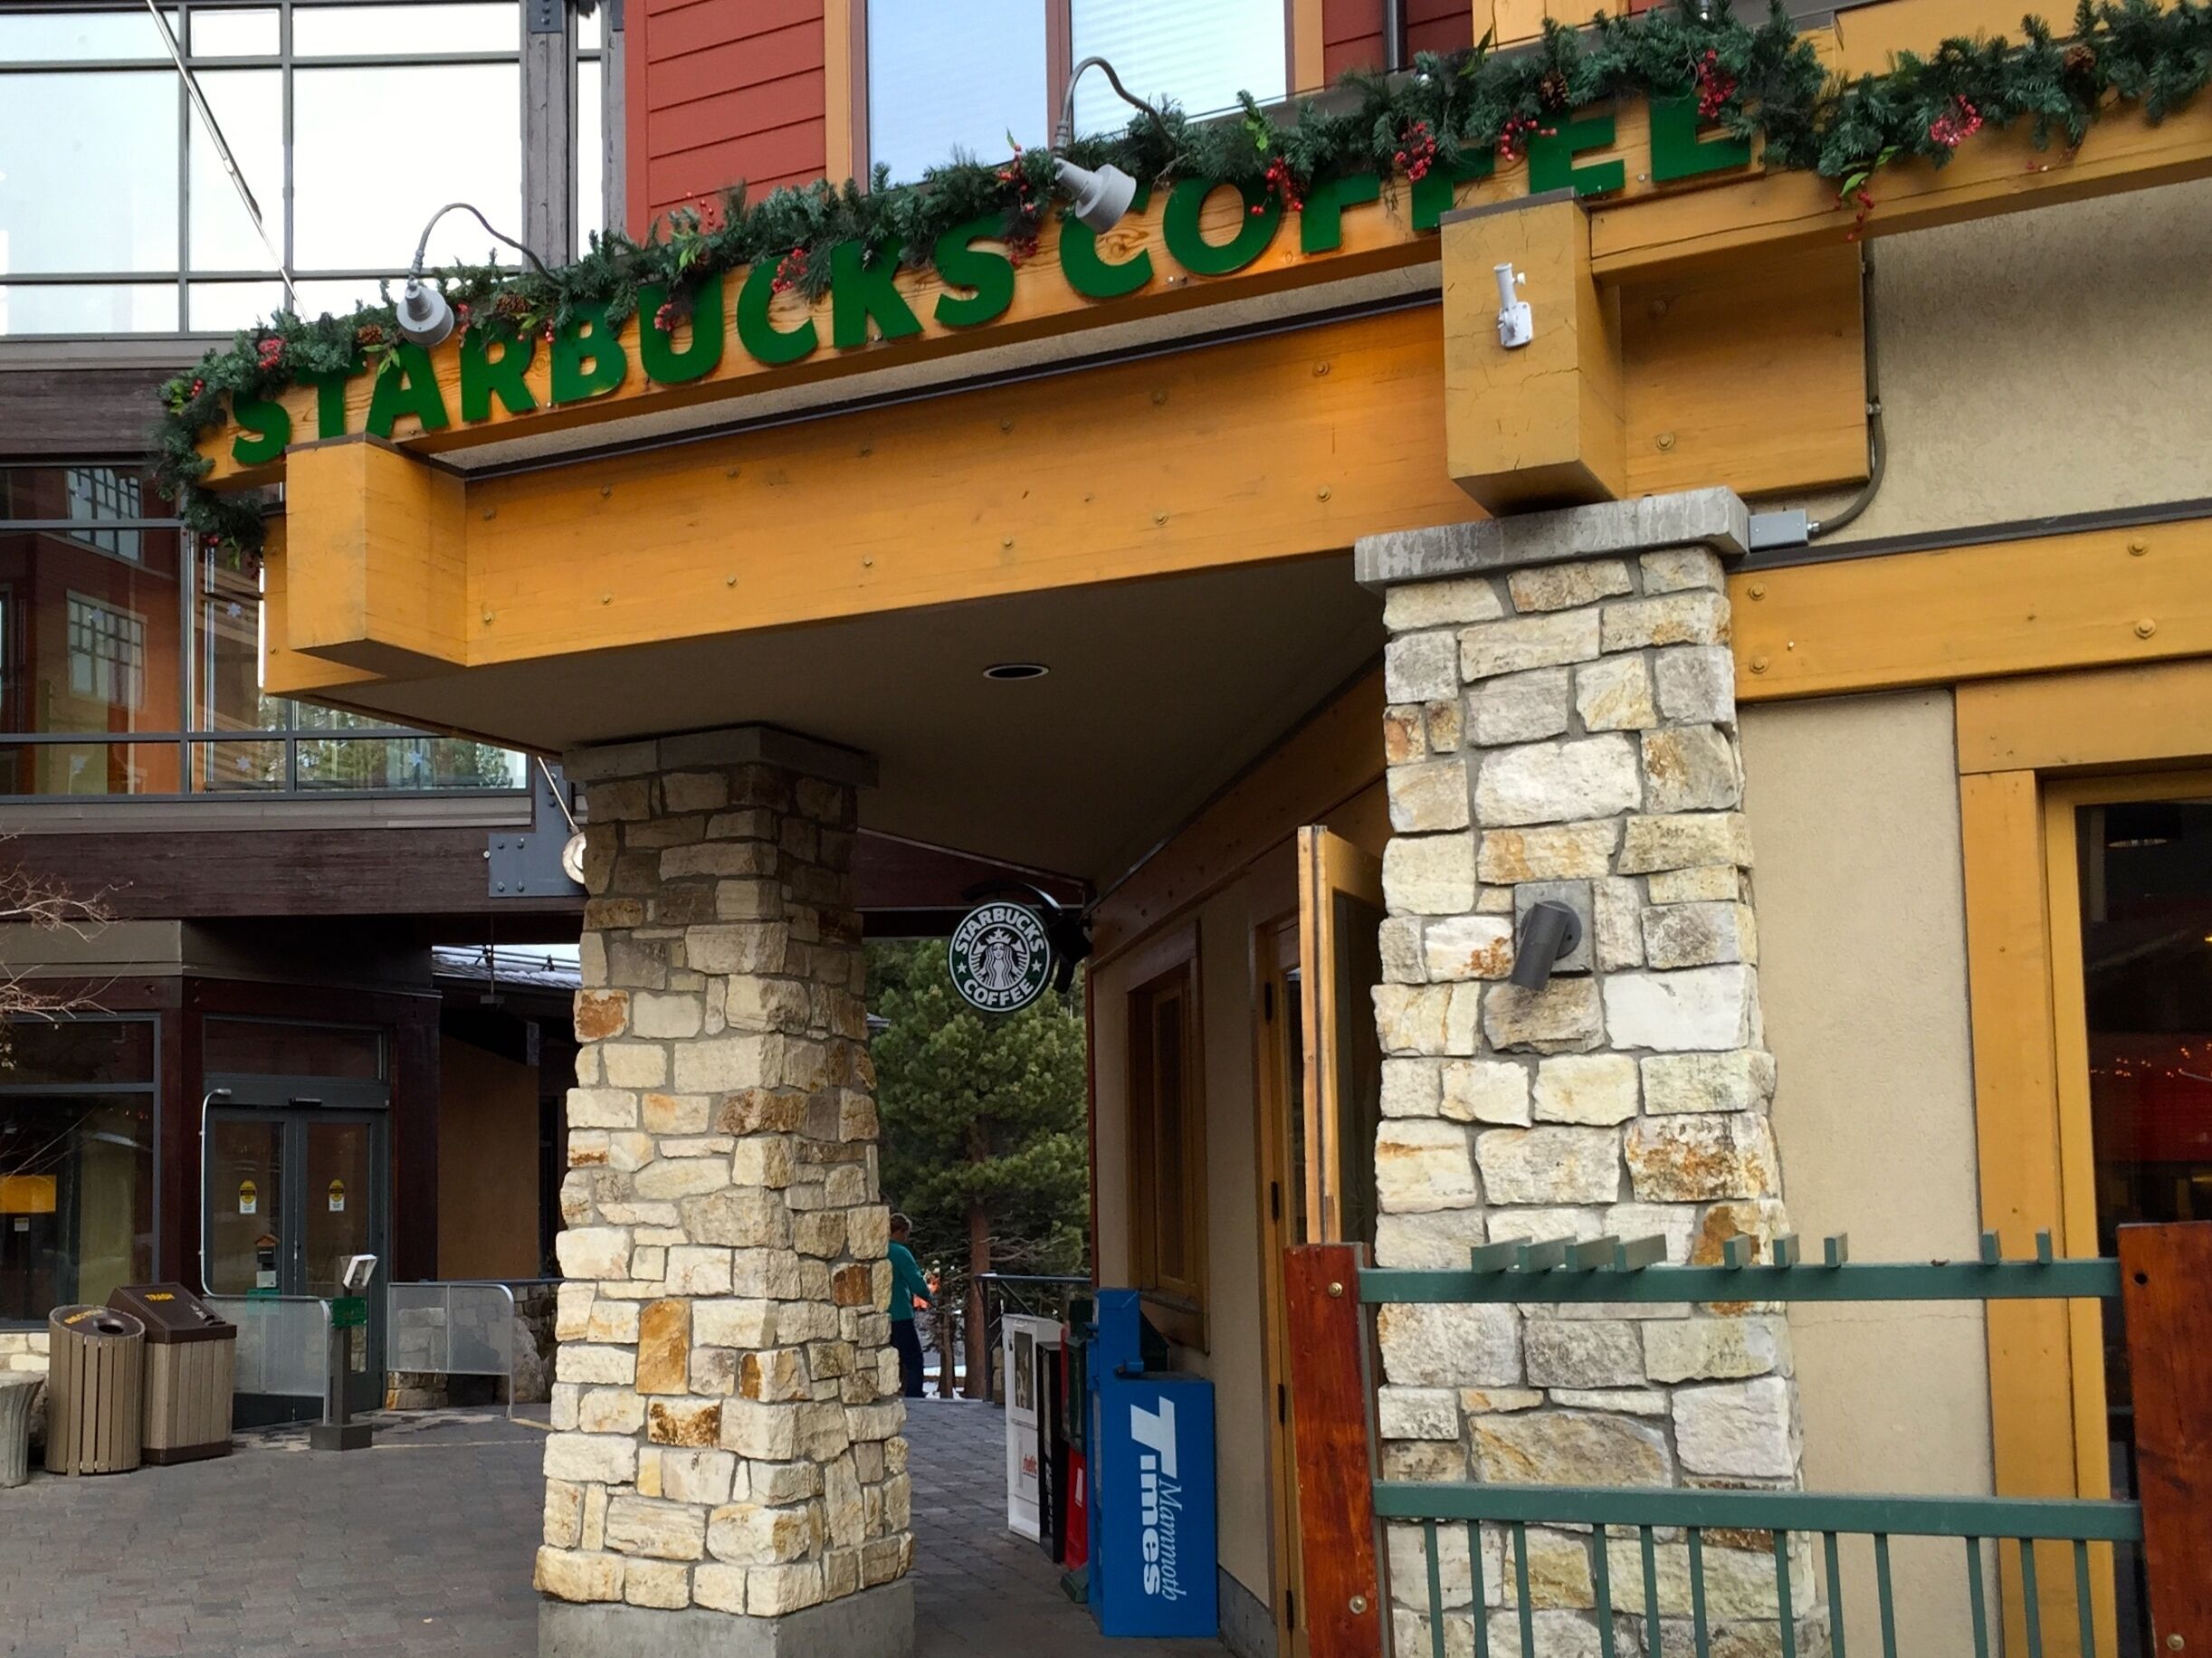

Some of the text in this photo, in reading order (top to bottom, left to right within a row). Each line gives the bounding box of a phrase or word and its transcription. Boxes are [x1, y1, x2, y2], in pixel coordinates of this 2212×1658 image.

[232, 211, 1015, 465] STARBUCKS
[954, 908, 1044, 955] STARBUCKS
[963, 978, 1034, 1005] COFFEE
[1130, 1395, 1178, 1596] Times
[1158, 1478, 1187, 1602] Mammoth
